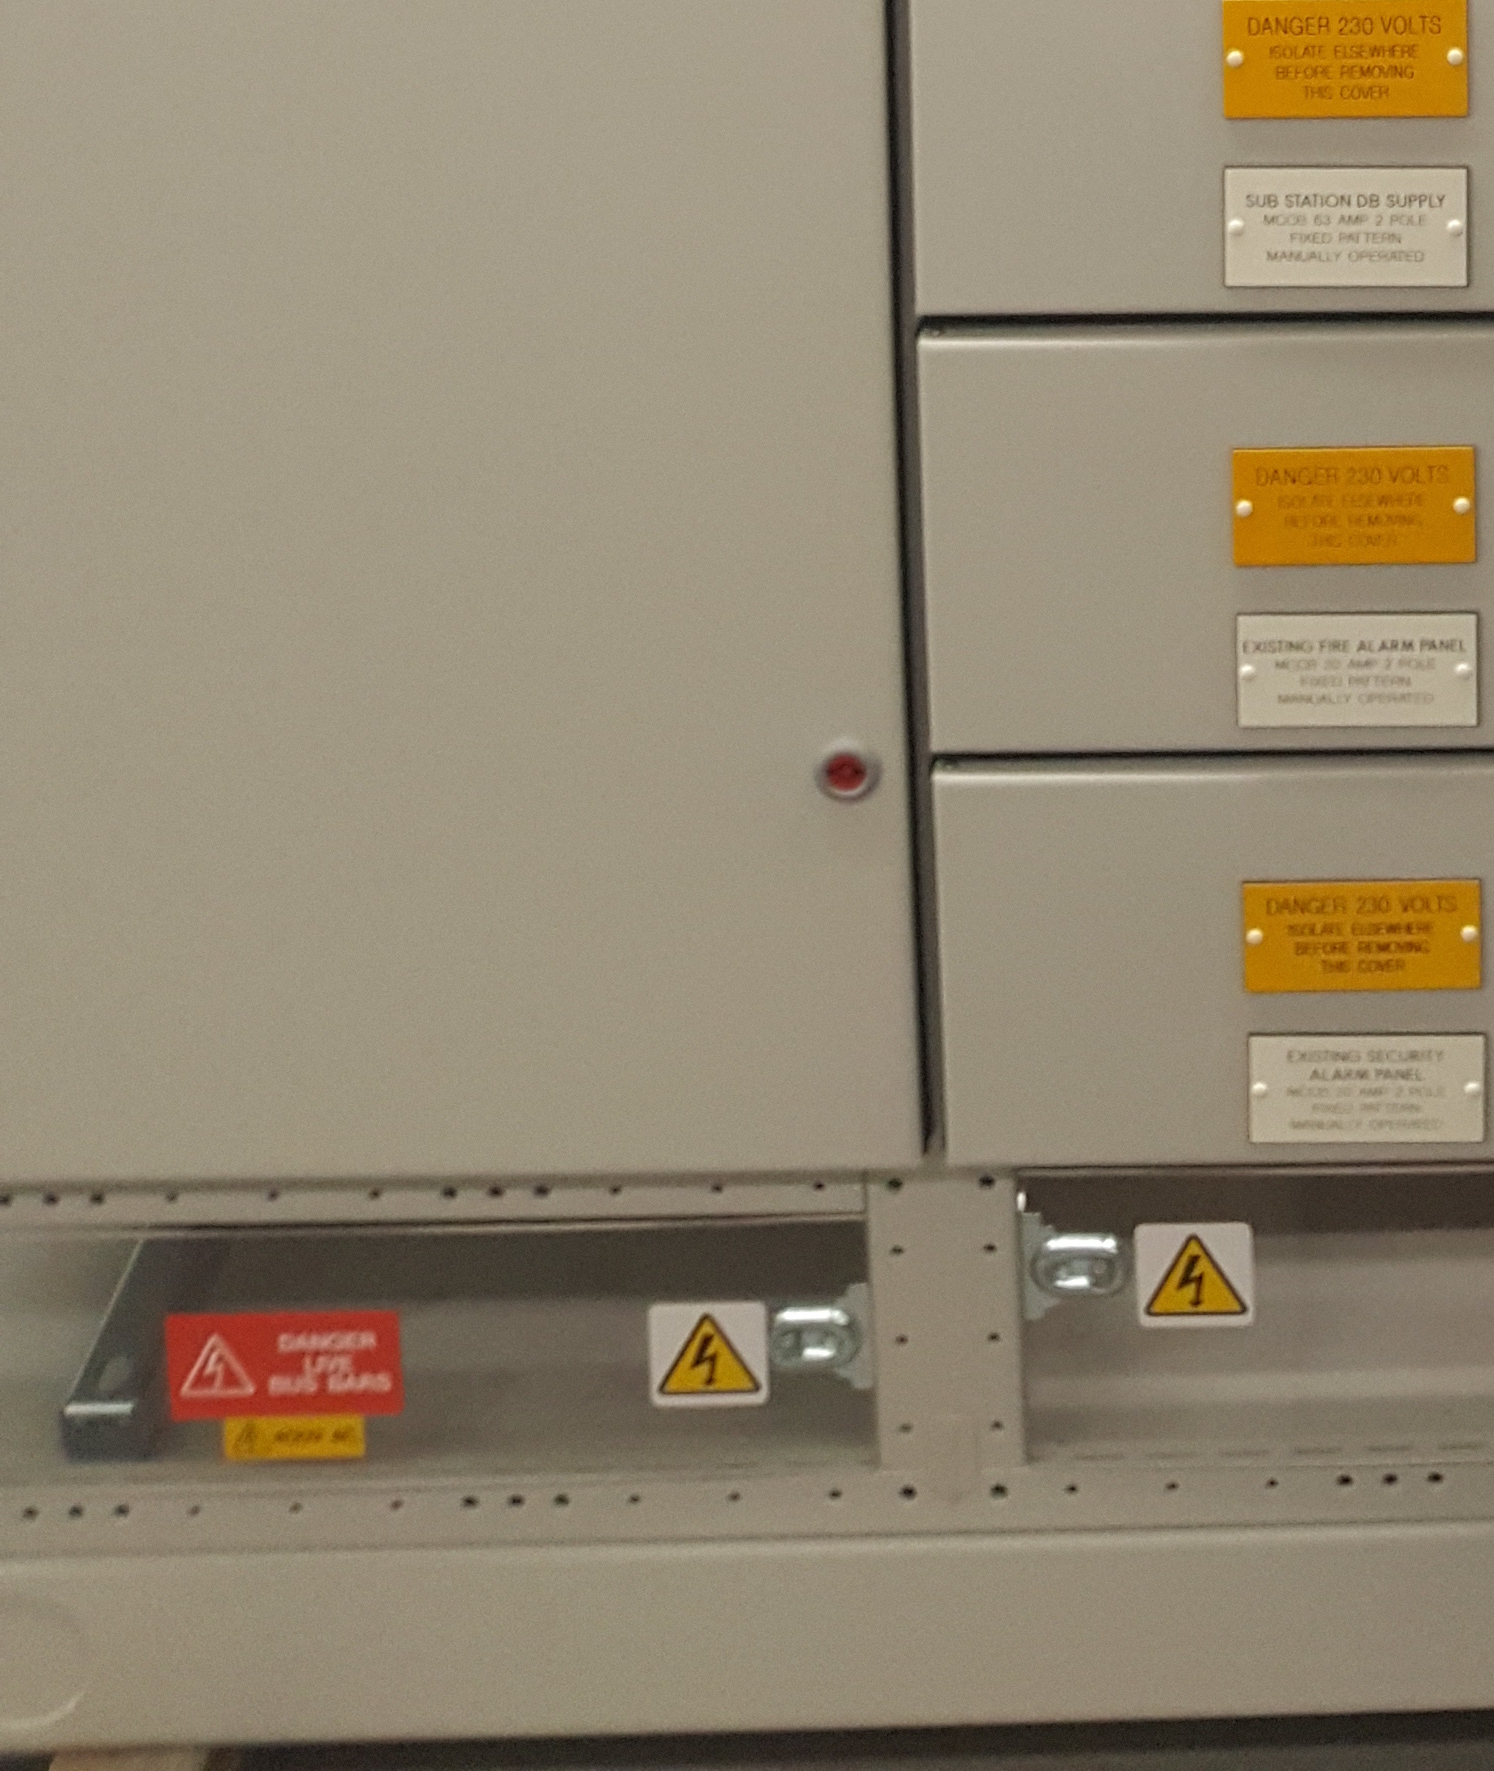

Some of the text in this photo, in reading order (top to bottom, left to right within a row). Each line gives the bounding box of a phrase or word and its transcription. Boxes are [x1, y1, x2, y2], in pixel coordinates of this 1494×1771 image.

[1248, 15, 1441, 36] DANGER 230 VOLTS
[1270, 45, 1326, 59] ISOLATE
[1340, 86, 1389, 99] COVER
[1246, 194, 1445, 209] SUB STATION DB SUPPLY
[1242, 639, 1466, 654] EXISTING FIRE ALARM PANEL
